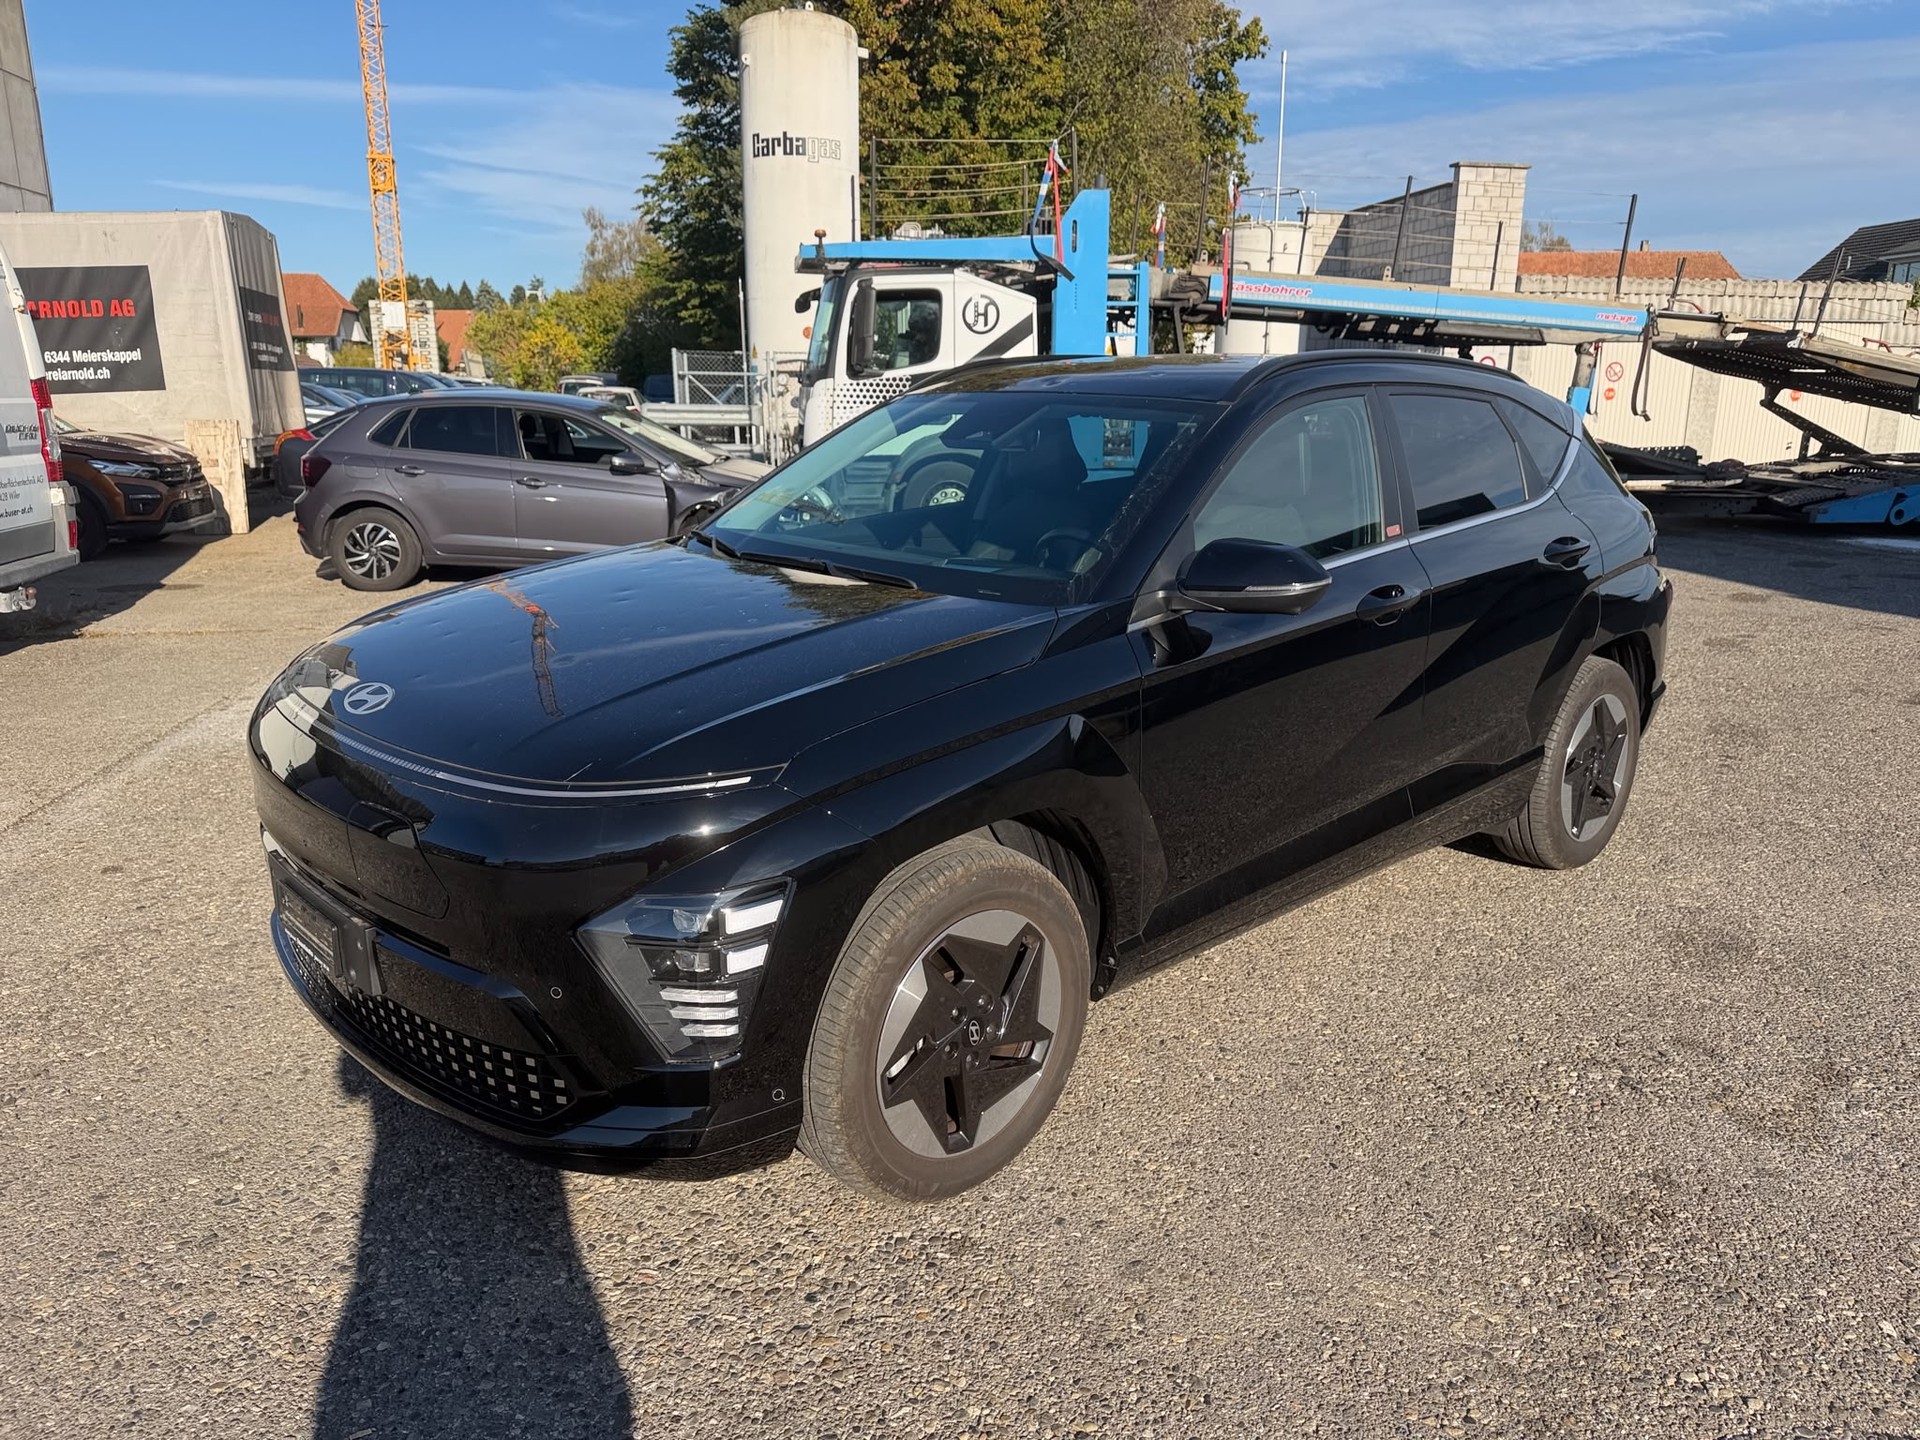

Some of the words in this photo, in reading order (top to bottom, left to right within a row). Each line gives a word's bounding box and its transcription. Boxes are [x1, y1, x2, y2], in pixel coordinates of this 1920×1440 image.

[752, 131, 841, 163] Carbagas
[27, 299, 104, 318] ARNOLD
[110, 299, 136, 317] AG
[44, 350, 70, 363] 6344
[72, 347, 142, 364] Meierskappel
